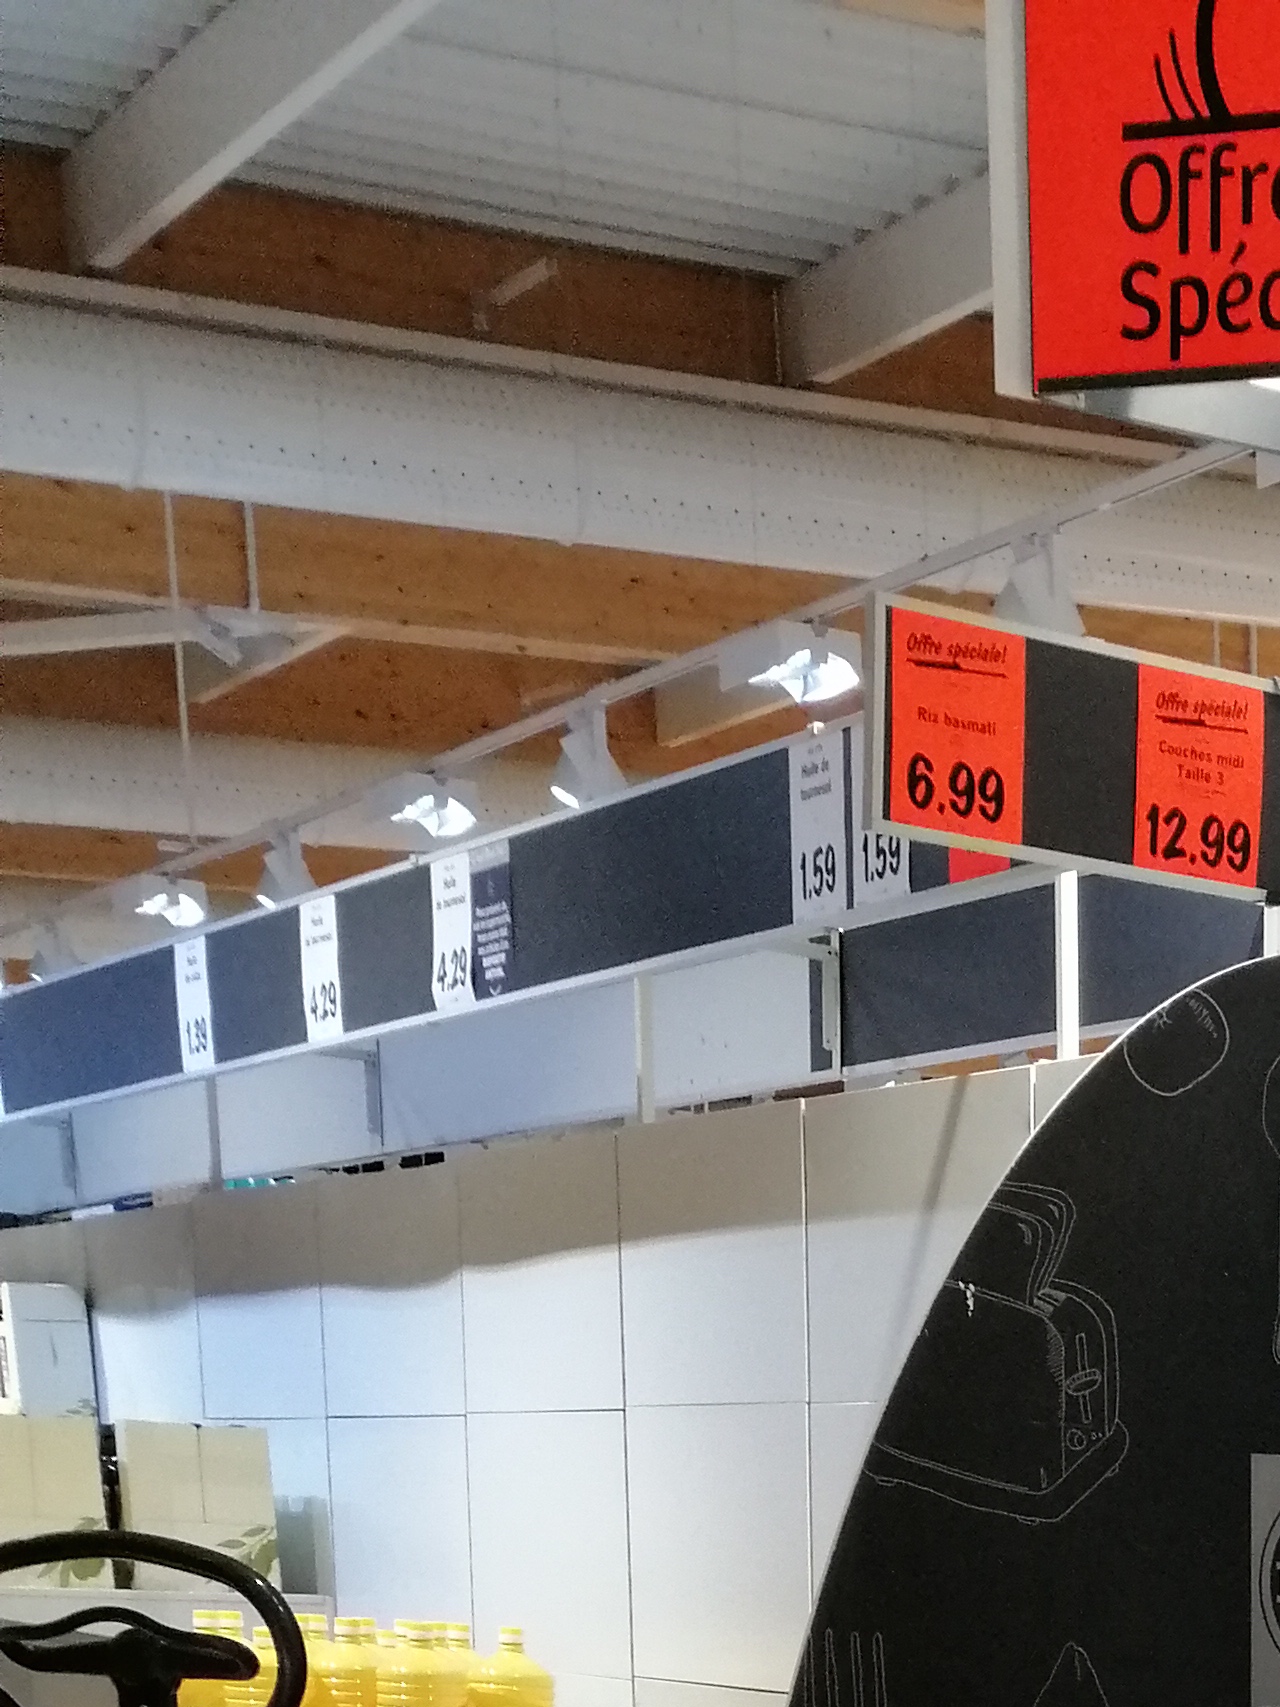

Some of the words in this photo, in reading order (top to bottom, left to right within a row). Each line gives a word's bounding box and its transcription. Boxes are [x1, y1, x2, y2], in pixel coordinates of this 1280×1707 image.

[906, 632, 942, 657] Offre
[917, 706, 939, 724] Riz
[944, 712, 997, 736] basmati
[1156, 690, 1188, 714] Offre
[1158, 741, 1213, 764] Couches
[1216, 754, 1245, 769] midi
[1177, 765, 1211, 784] Taille
[1216, 773, 1225, 786] 3
[907, 753, 1006, 823] 6.99
[863, 832, 901, 884] 1.59
[1146, 803, 1252, 873] 12.99
[800, 844, 836, 900] 1.59
[437, 945, 467, 993] 4.29
[310, 980, 337, 1024] 4.29
[186, 1015, 207, 1056] 1.39
